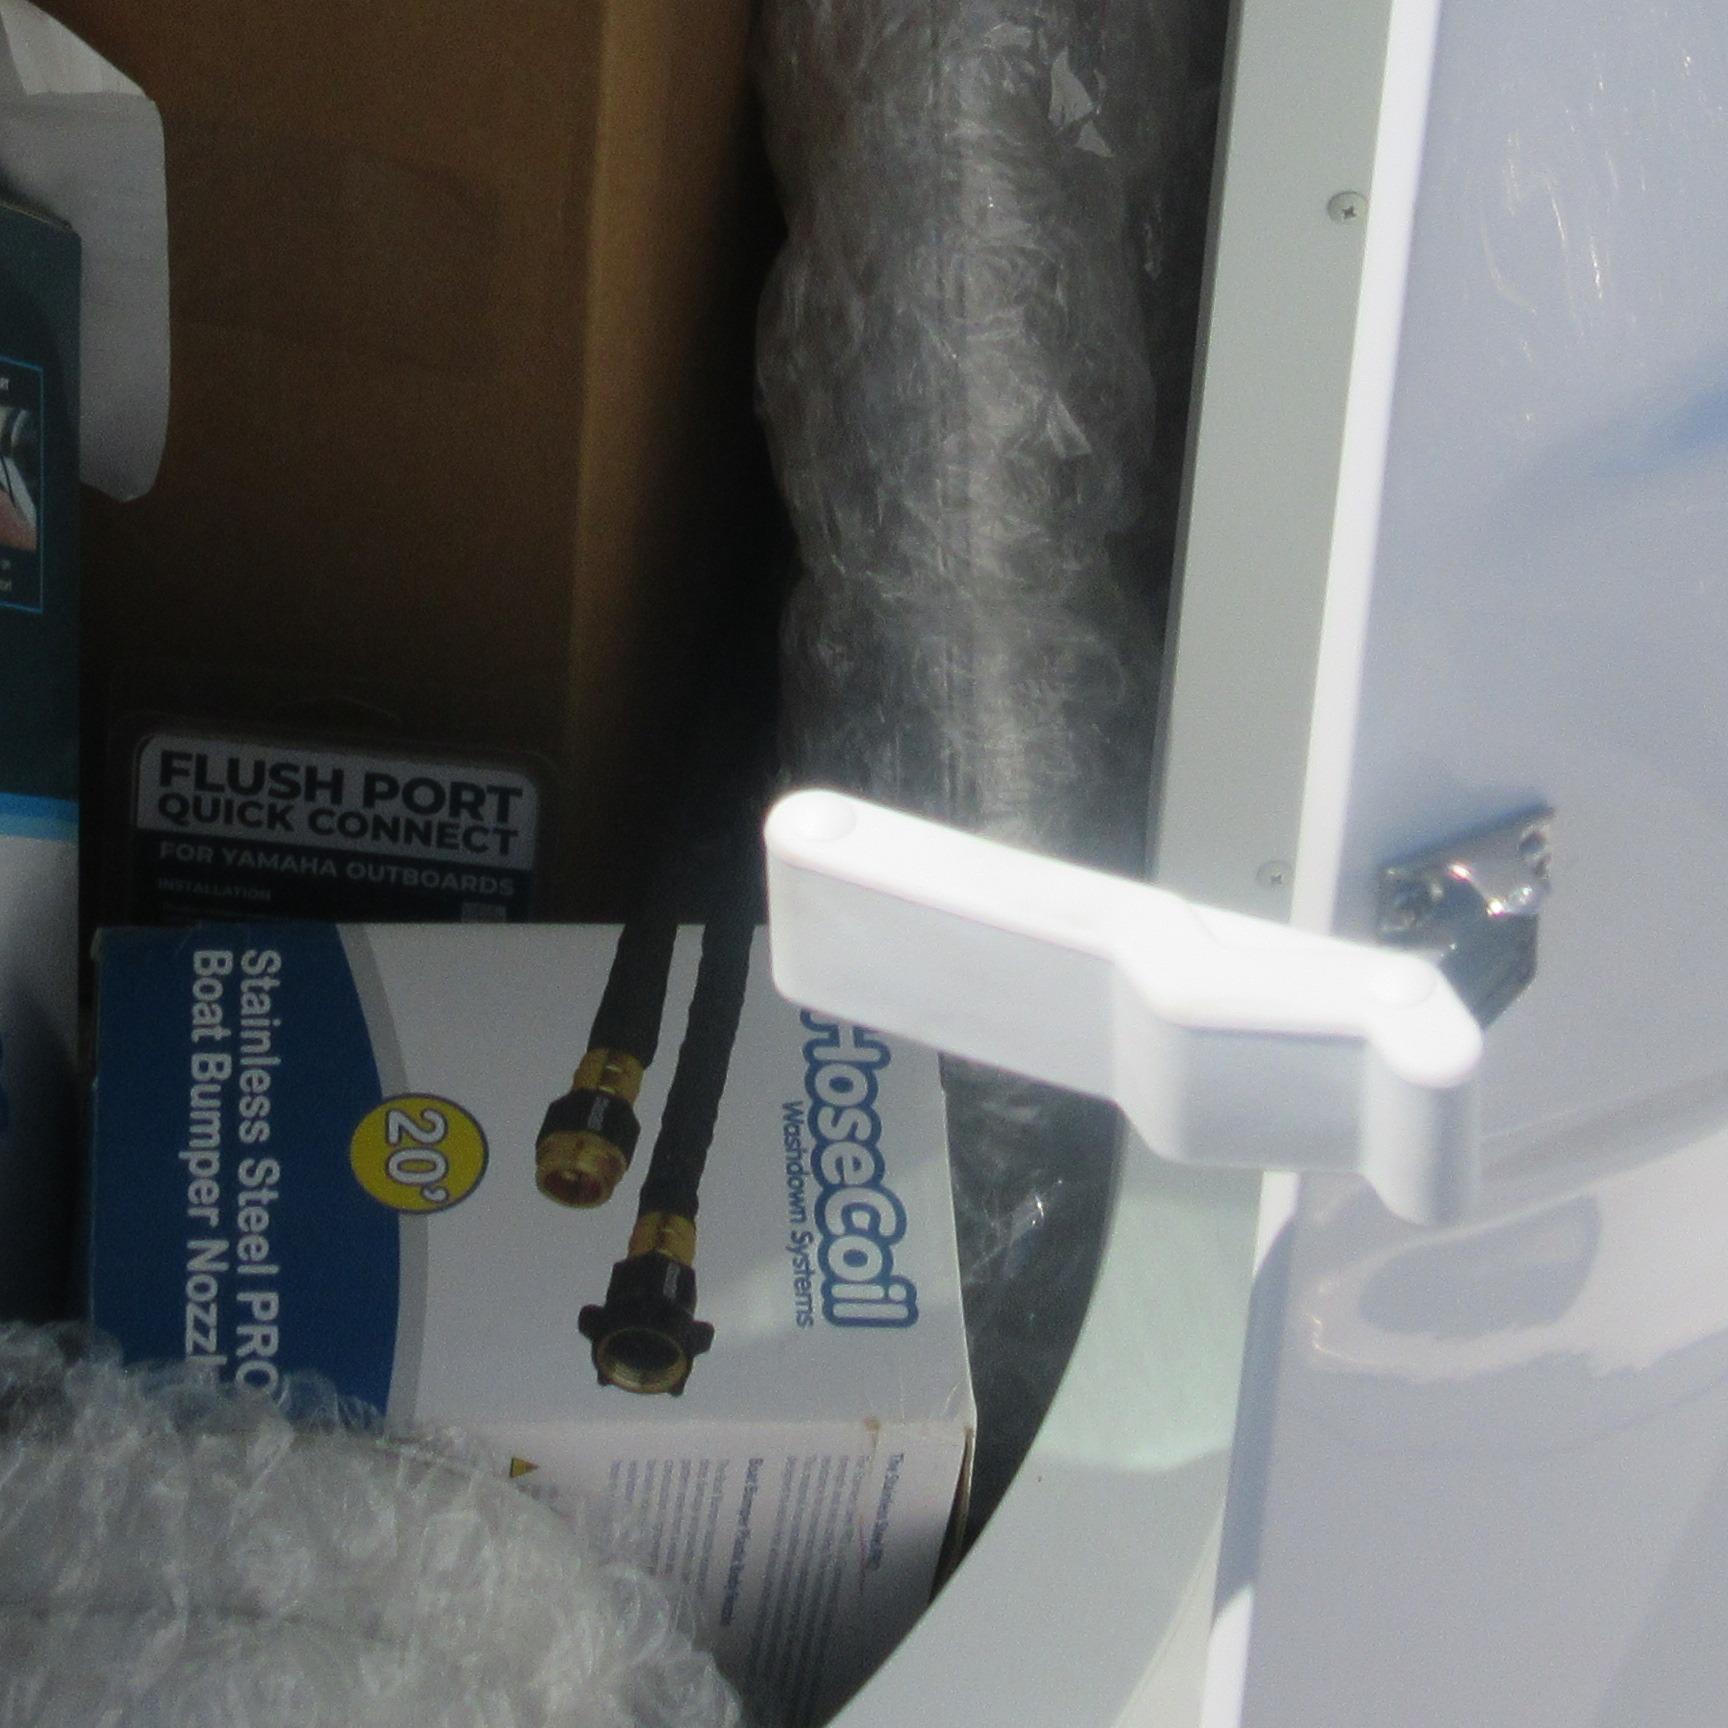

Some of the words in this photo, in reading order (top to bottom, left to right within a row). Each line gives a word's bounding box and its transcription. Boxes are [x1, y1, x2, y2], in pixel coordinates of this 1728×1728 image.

[158, 792, 295, 832] QUICK
[307, 807, 519, 856] CONNECT
[159, 749, 345, 805] FLUSH
[363, 772, 522, 823] PORT
[158, 877, 272, 901] INSTALLATION
[160, 841, 214, 864] FOR
[222, 847, 338, 878] YAMAHA
[347, 861, 515, 896] OUTBOARDS
[191, 950, 234, 1043] Boat
[239, 949, 282, 1143] Stainless
[178, 1053, 232, 1227] Bumper
[782, 1100, 807, 1226] Washdown
[800, 1007, 919, 1329] HoseCoil
[237, 1158, 281, 1274] Steel
[185, 1239, 230, 1368] Nozzl
[786, 1229, 815, 1330] Systems
[235, 1292, 280, 1392] PRO
